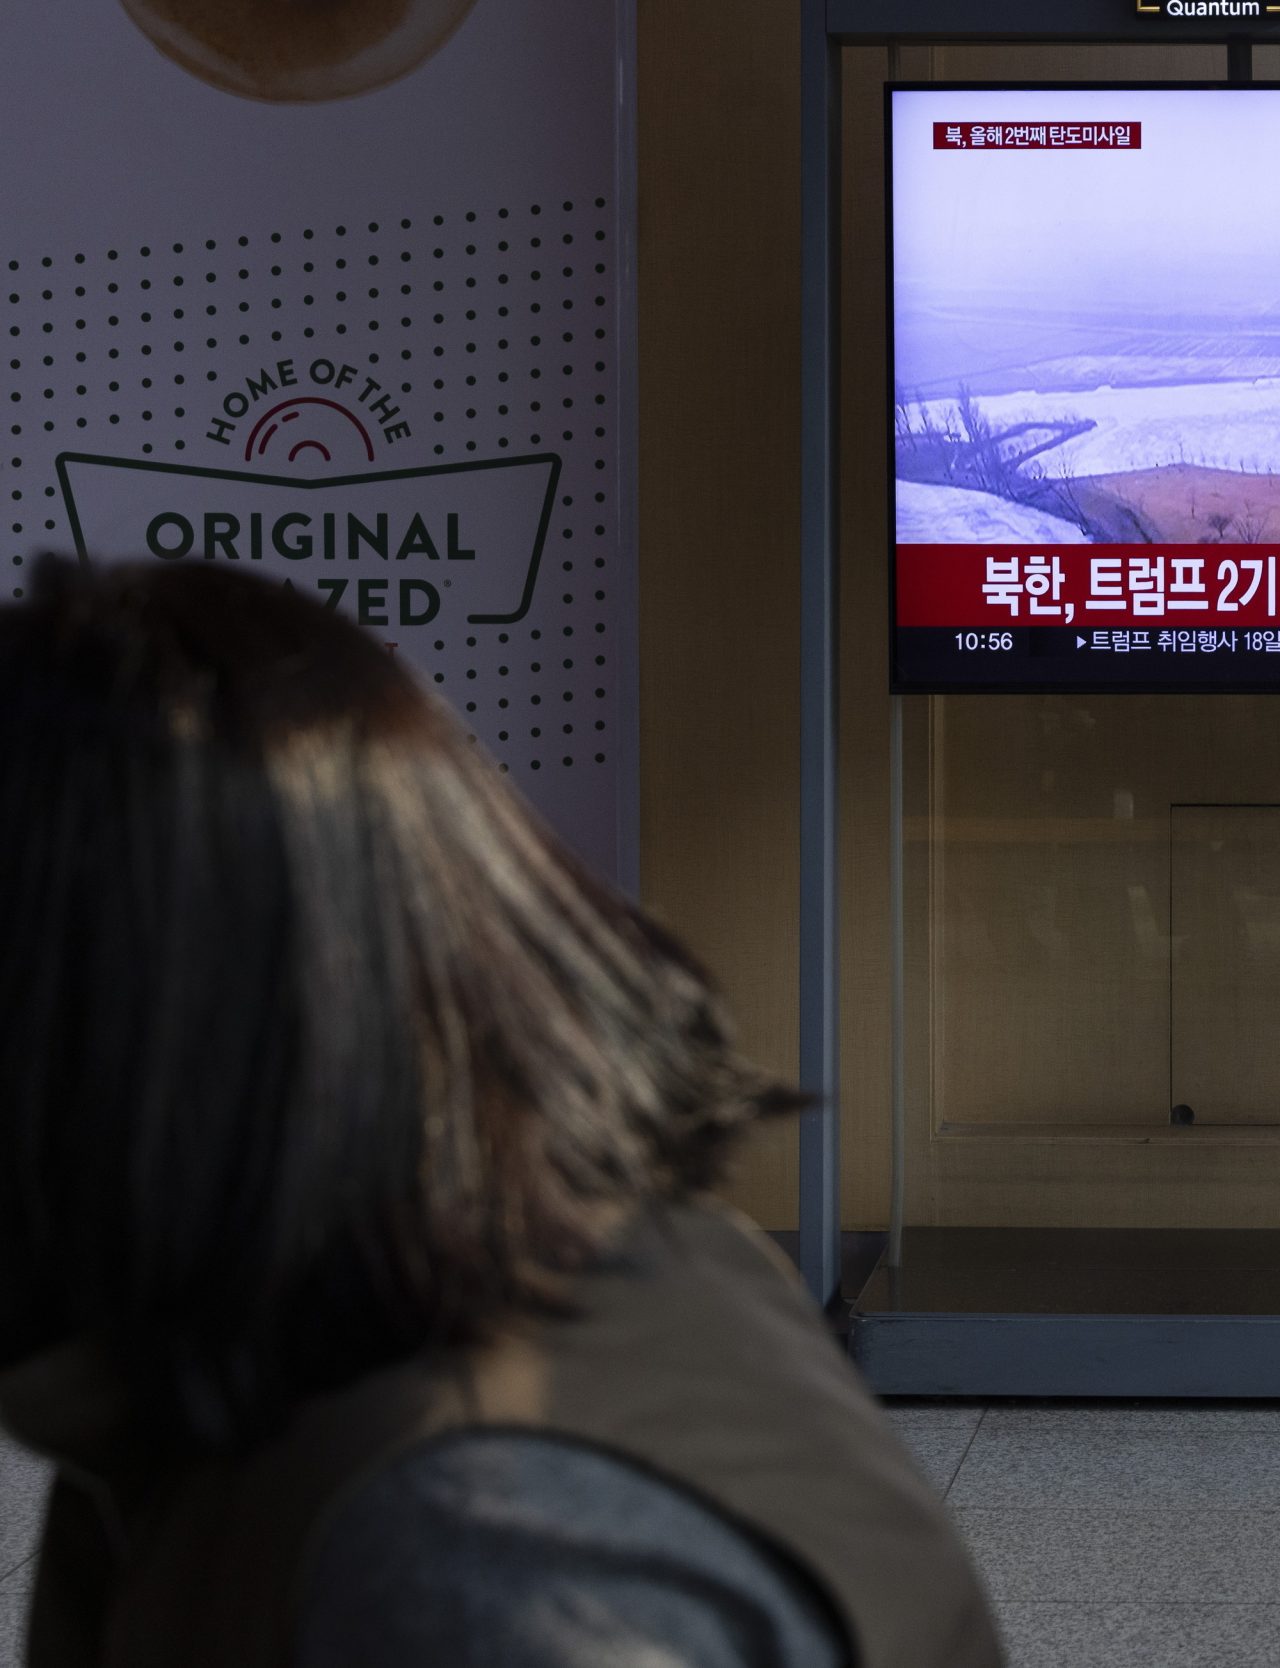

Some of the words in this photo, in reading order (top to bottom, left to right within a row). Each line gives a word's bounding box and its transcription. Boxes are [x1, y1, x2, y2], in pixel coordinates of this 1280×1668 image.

[1166, 0, 1260, 16] Quantum
[945, 126, 967, 148] 북,
[969, 126, 1003, 146] 올해
[1005, 126, 1047, 146] 2번째
[1049, 126, 1131, 146] 탄도미사일
[206, 358, 298, 445] HOME
[309, 358, 358, 389] OF
[358, 377, 411, 444] THE
[146, 512, 476, 561] ORIGINAL
[981, 556, 1075, 624] 북한,
[1085, 556, 1209, 616] 트럼프
[1217, 556, 1276, 617] 2기
[955, 632, 1013, 651] 10:56
[1090, 630, 1152, 652] 트럼프
[1157, 630, 1239, 653] 취임행사
